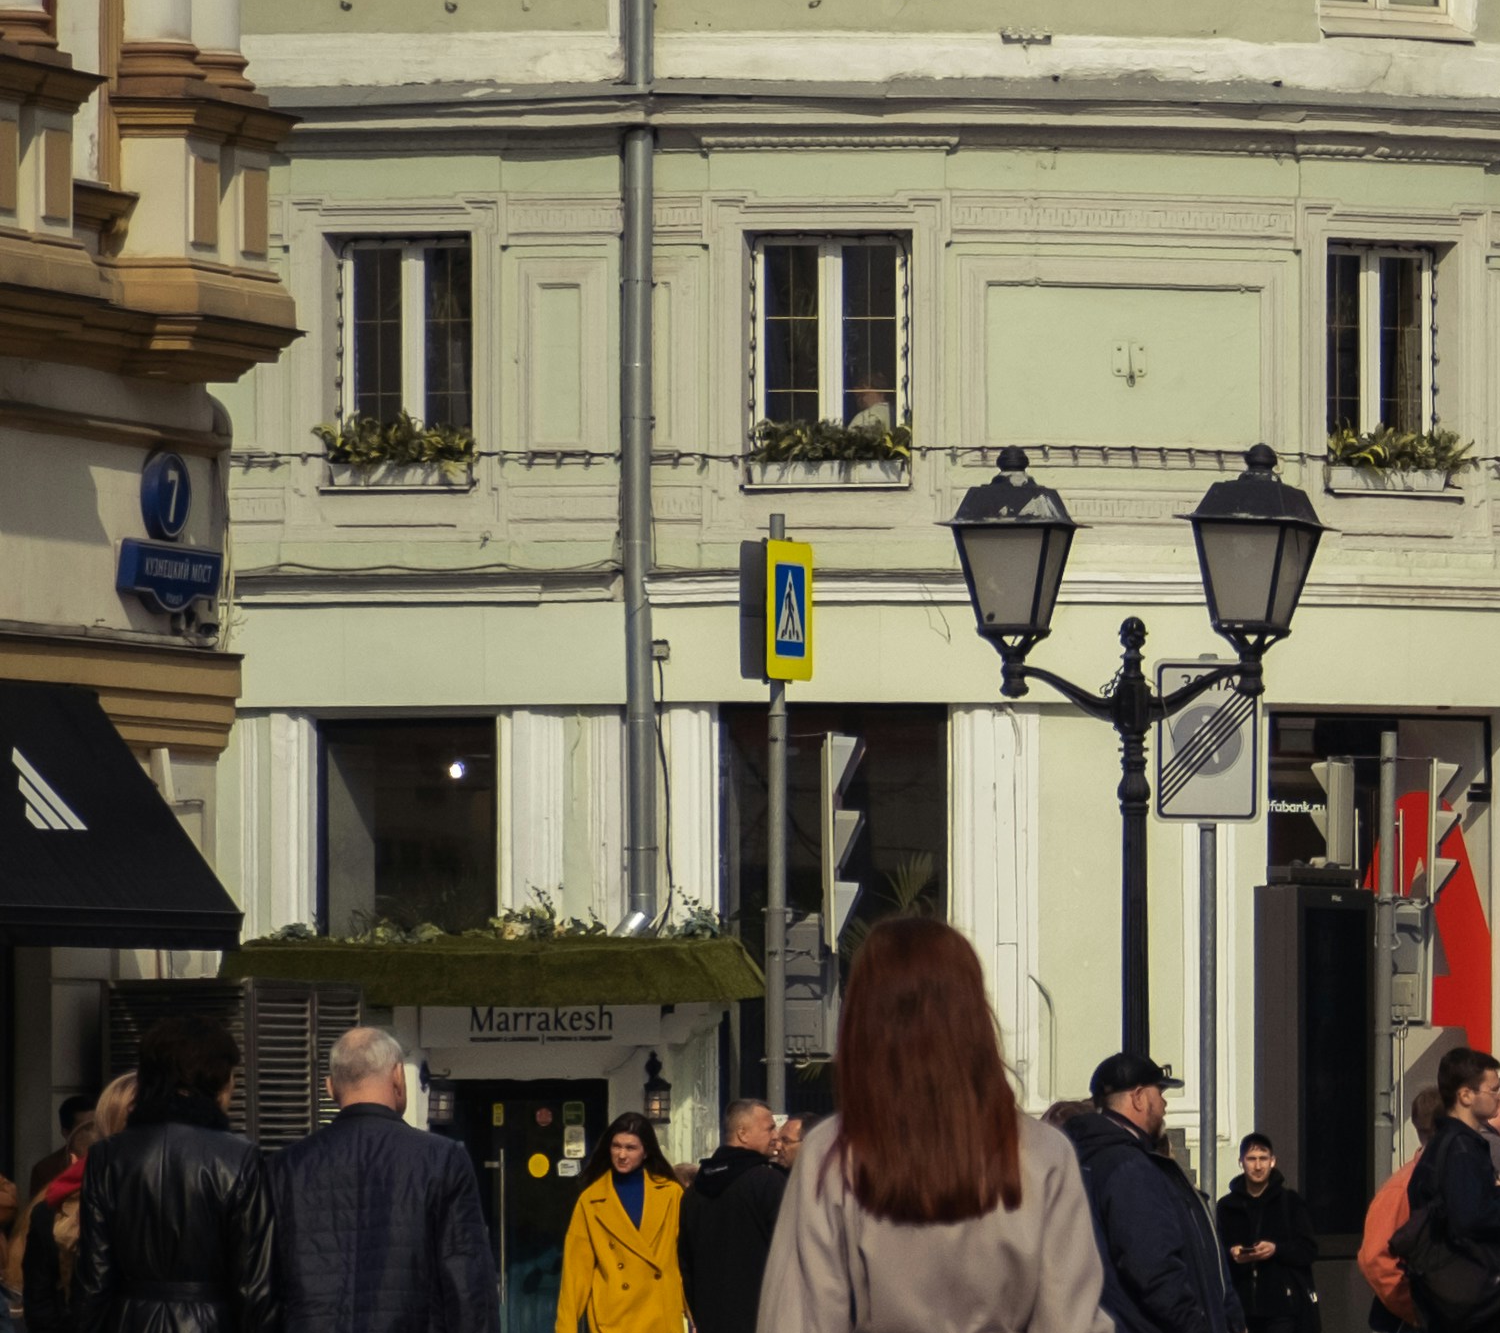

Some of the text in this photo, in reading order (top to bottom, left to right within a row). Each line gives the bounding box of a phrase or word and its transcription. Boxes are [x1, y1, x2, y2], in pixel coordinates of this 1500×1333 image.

[167, 469, 180, 523] 7
[145, 556, 189, 580] КУЗНЕЦКИЙ
[469, 1006, 614, 1032] Marrakesh
